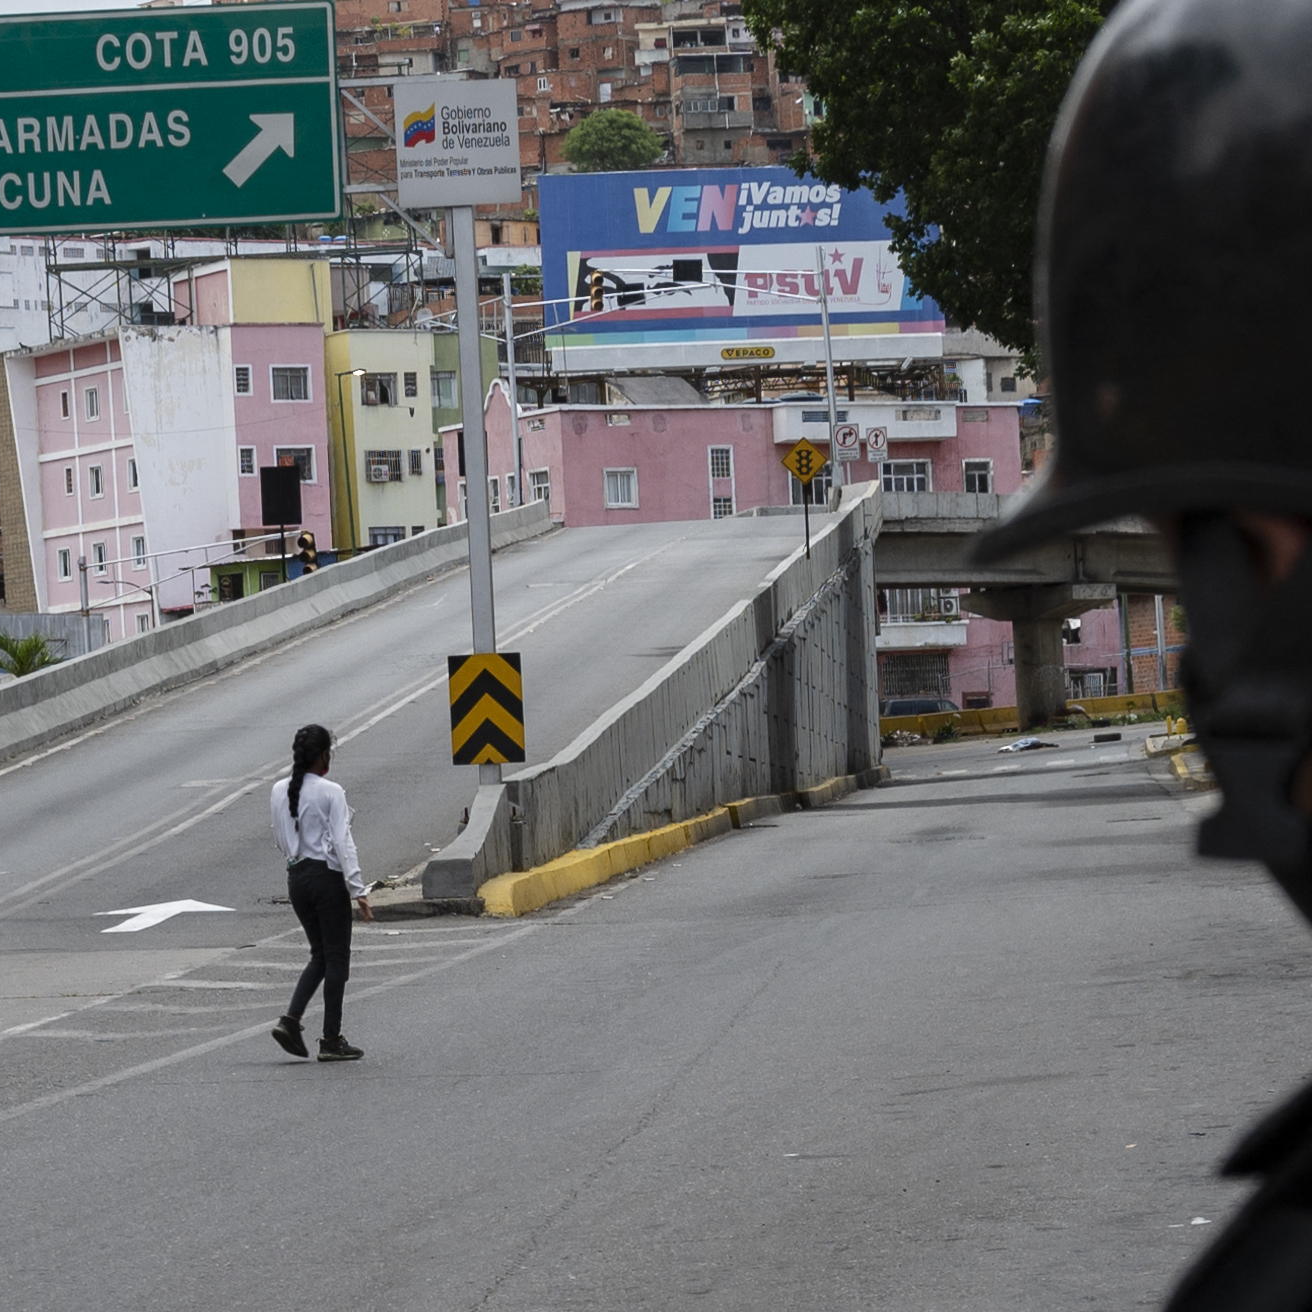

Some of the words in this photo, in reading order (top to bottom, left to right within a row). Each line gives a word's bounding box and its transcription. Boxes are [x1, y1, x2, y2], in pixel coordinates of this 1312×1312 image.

[96, 31, 209, 72] COTA
[229, 27, 296, 65] 905
[440, 105, 492, 121] Gobierno
[442, 119, 507, 135] Bolivariano
[441, 136, 455, 150] de
[457, 134, 510, 149] Venezuela
[414, 168, 445, 180] Transporte
[633, 184, 738, 234] VEN
